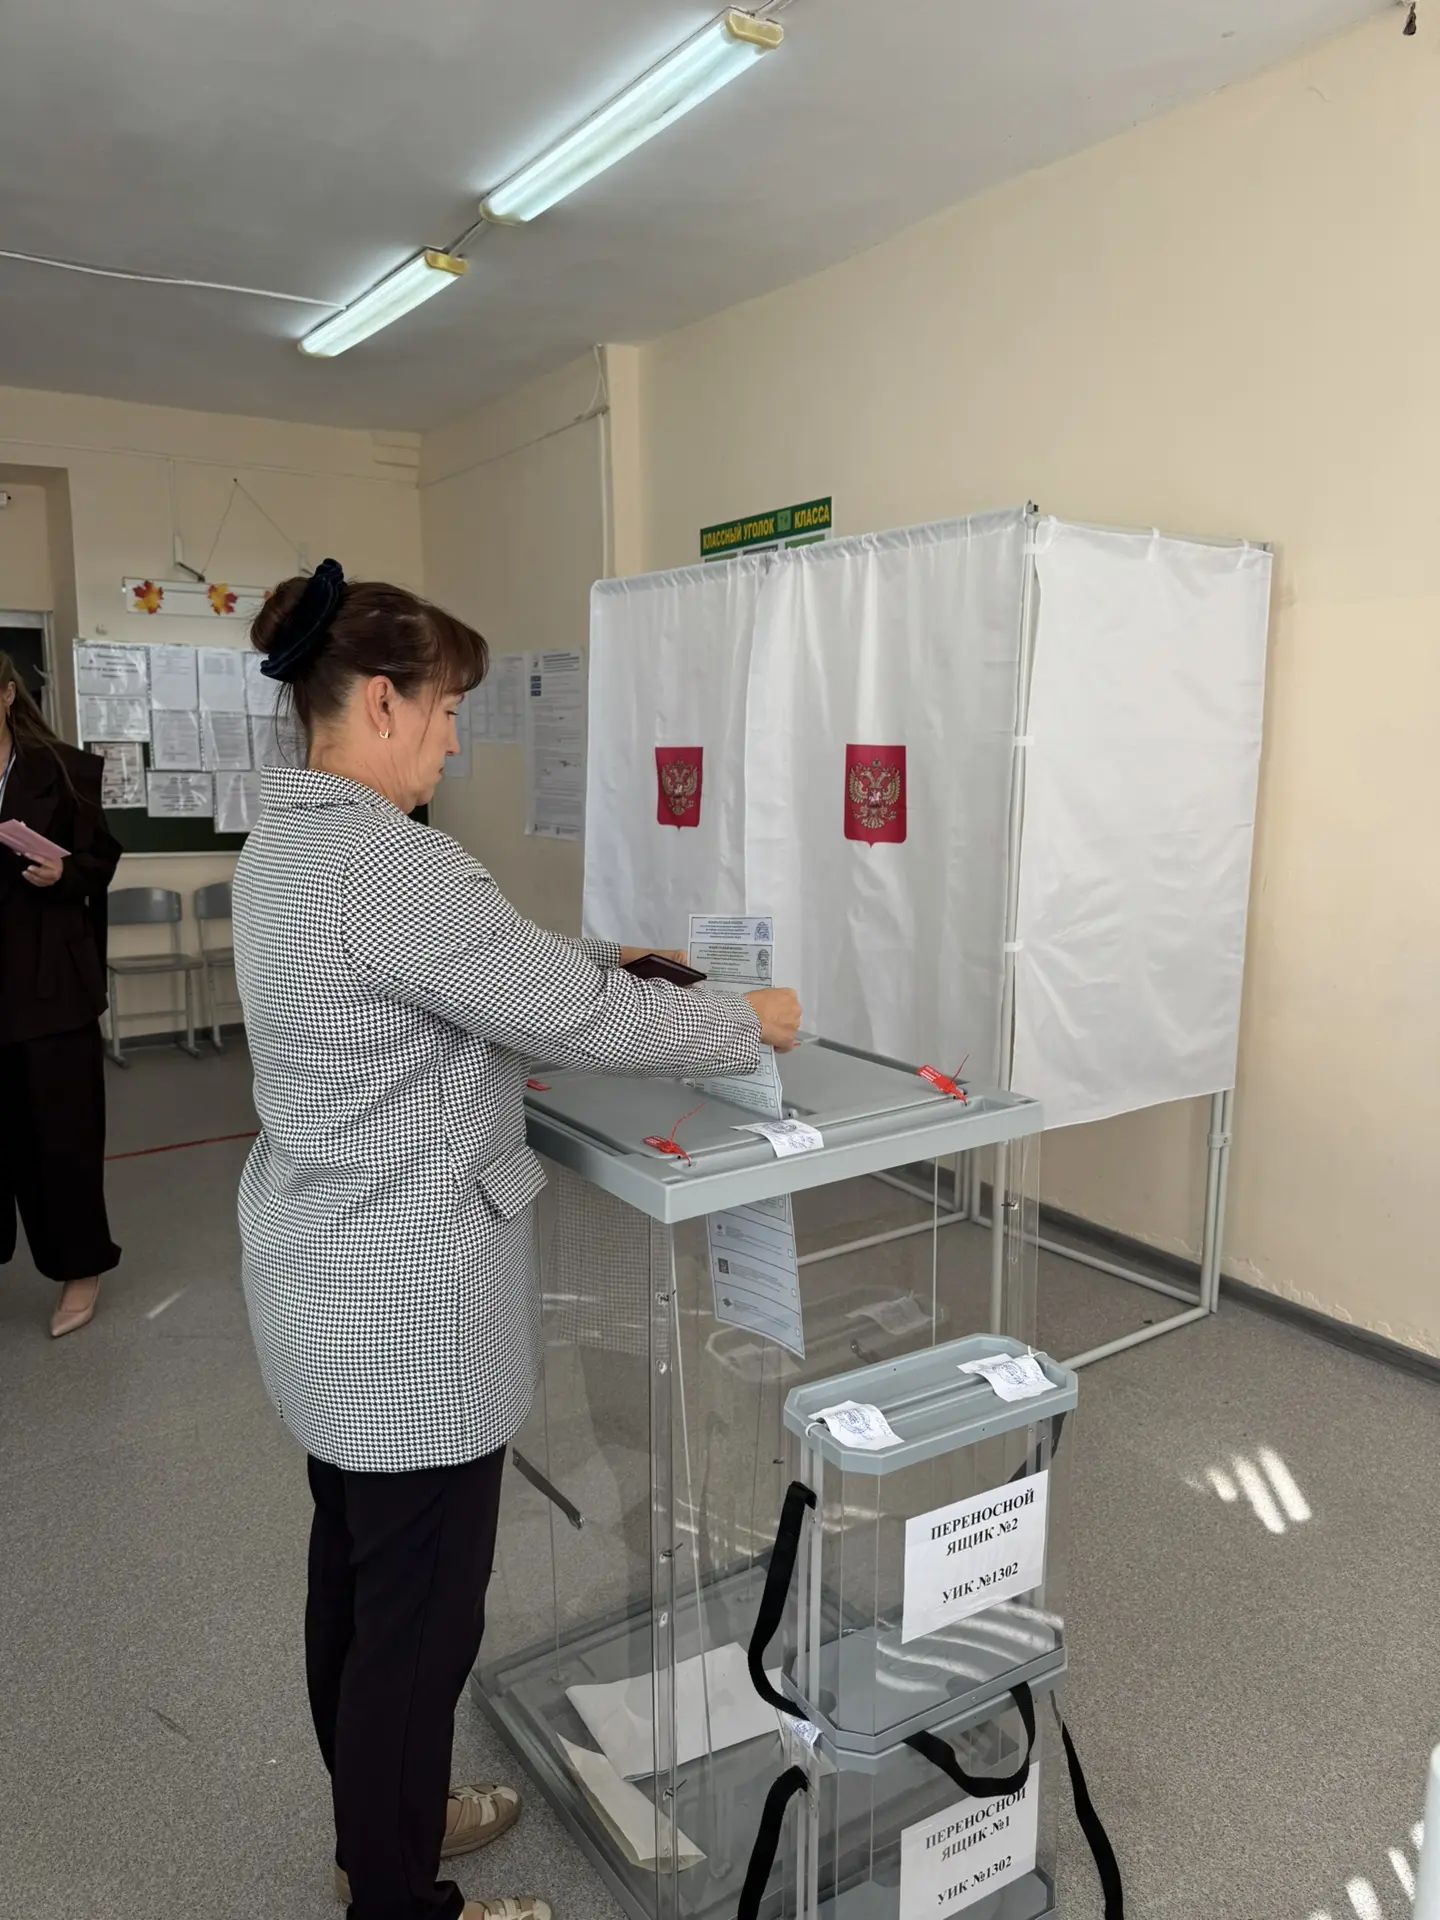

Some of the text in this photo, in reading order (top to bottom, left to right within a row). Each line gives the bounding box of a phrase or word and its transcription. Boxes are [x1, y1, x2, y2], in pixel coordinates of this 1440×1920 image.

[703, 523, 742, 548] КЛАССНЫЙ
[743, 518, 775, 540] УГОЛОК
[794, 505, 830, 528] КЛАССА
[931, 1488, 1035, 1540] ПЕРЕНОСНОЙ
[946, 1518, 1019, 1556] ЯЩИК №2
[942, 1562, 1019, 1603] УИК №1302
[941, 1815, 1010, 1862] ЯЩИК №1
[937, 1855, 1012, 1905] УИК №1302
